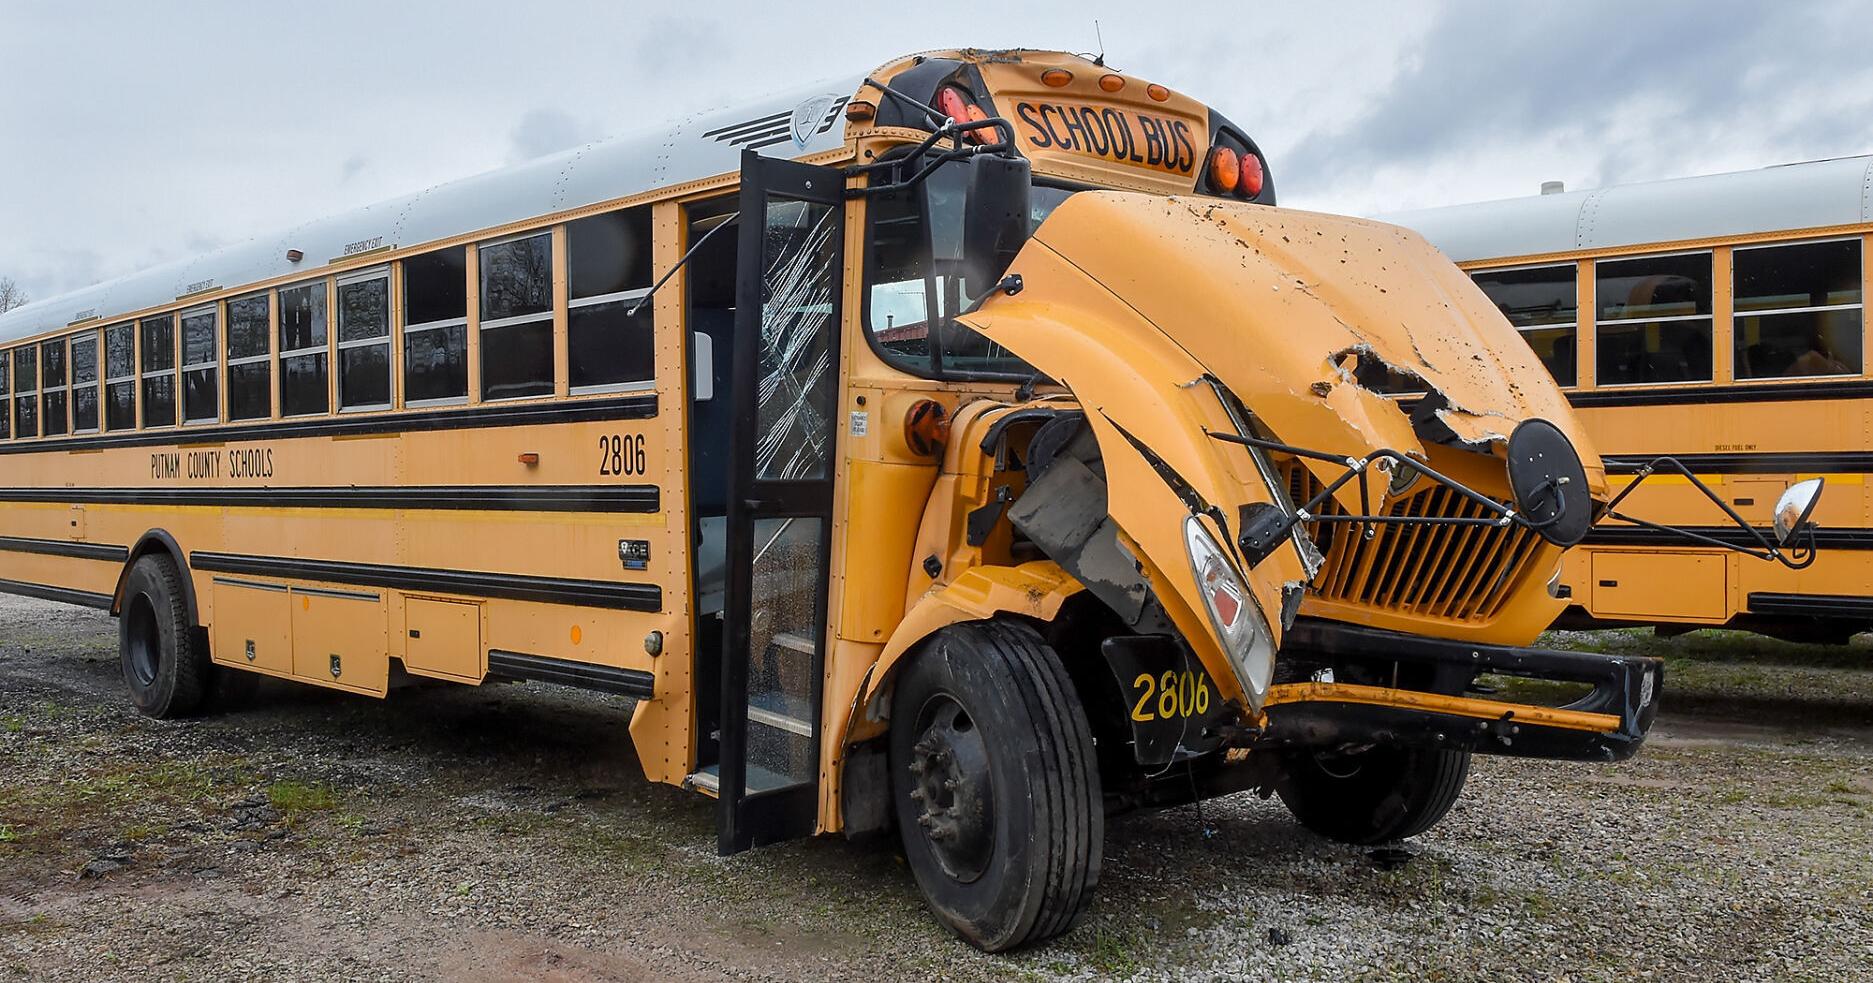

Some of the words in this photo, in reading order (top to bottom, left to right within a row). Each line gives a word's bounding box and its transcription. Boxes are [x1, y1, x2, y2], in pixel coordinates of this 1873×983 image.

[1016, 102, 1143, 163] SCHOOL
[1137, 115, 1194, 173] BUS
[344, 240, 371, 255] EMERGENCY
[370, 236, 382, 249] EXIT
[151, 453, 181, 479] PUTNAM
[187, 451, 221, 479] COUNTY
[229, 448, 273, 478] SCHOOLS
[599, 433, 646, 476] 2806
[1131, 670, 1209, 722] 2806
